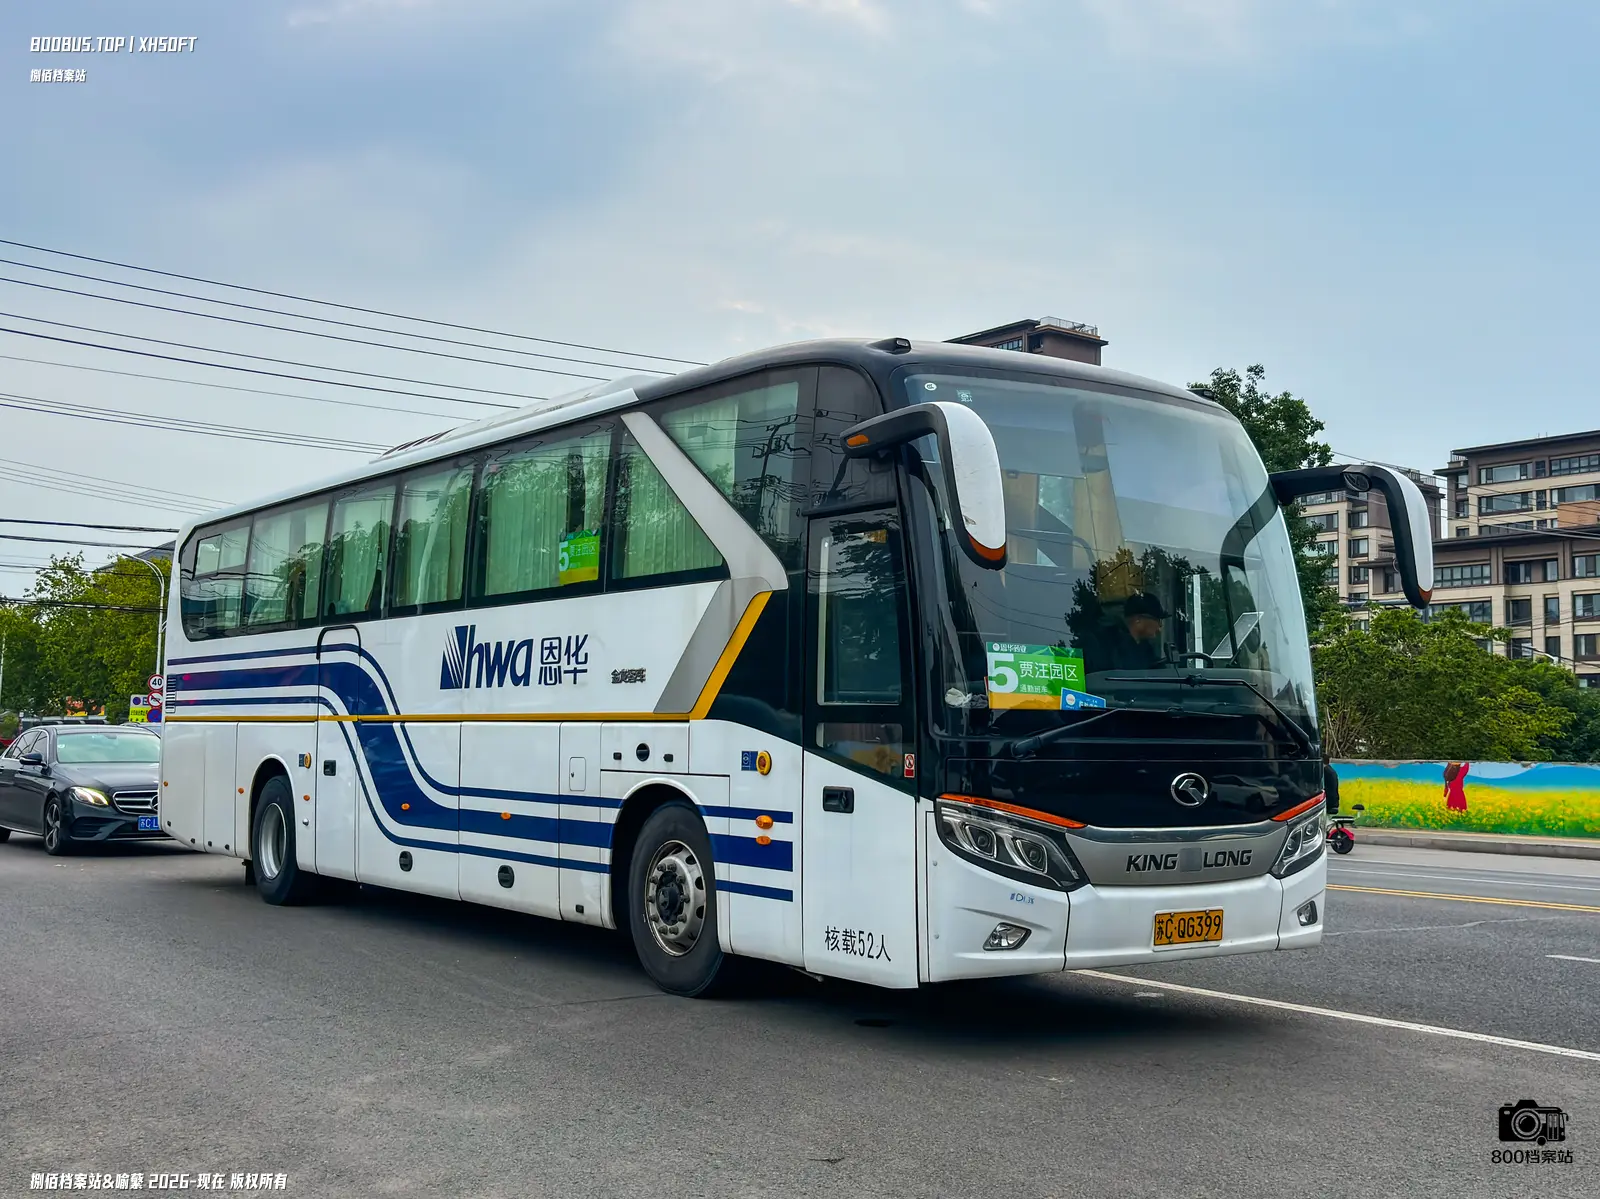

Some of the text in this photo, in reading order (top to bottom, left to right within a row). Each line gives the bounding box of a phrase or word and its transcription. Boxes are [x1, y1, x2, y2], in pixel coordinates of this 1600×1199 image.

[538, 634, 588, 686] 恩华
[987, 652, 1019, 693] 5
[1019, 660, 1079, 681] 贾汪园区
[151, 678, 163, 686] 40
[1125, 850, 1252, 872] KING LONG
[824, 925, 892, 963] 核载52人
